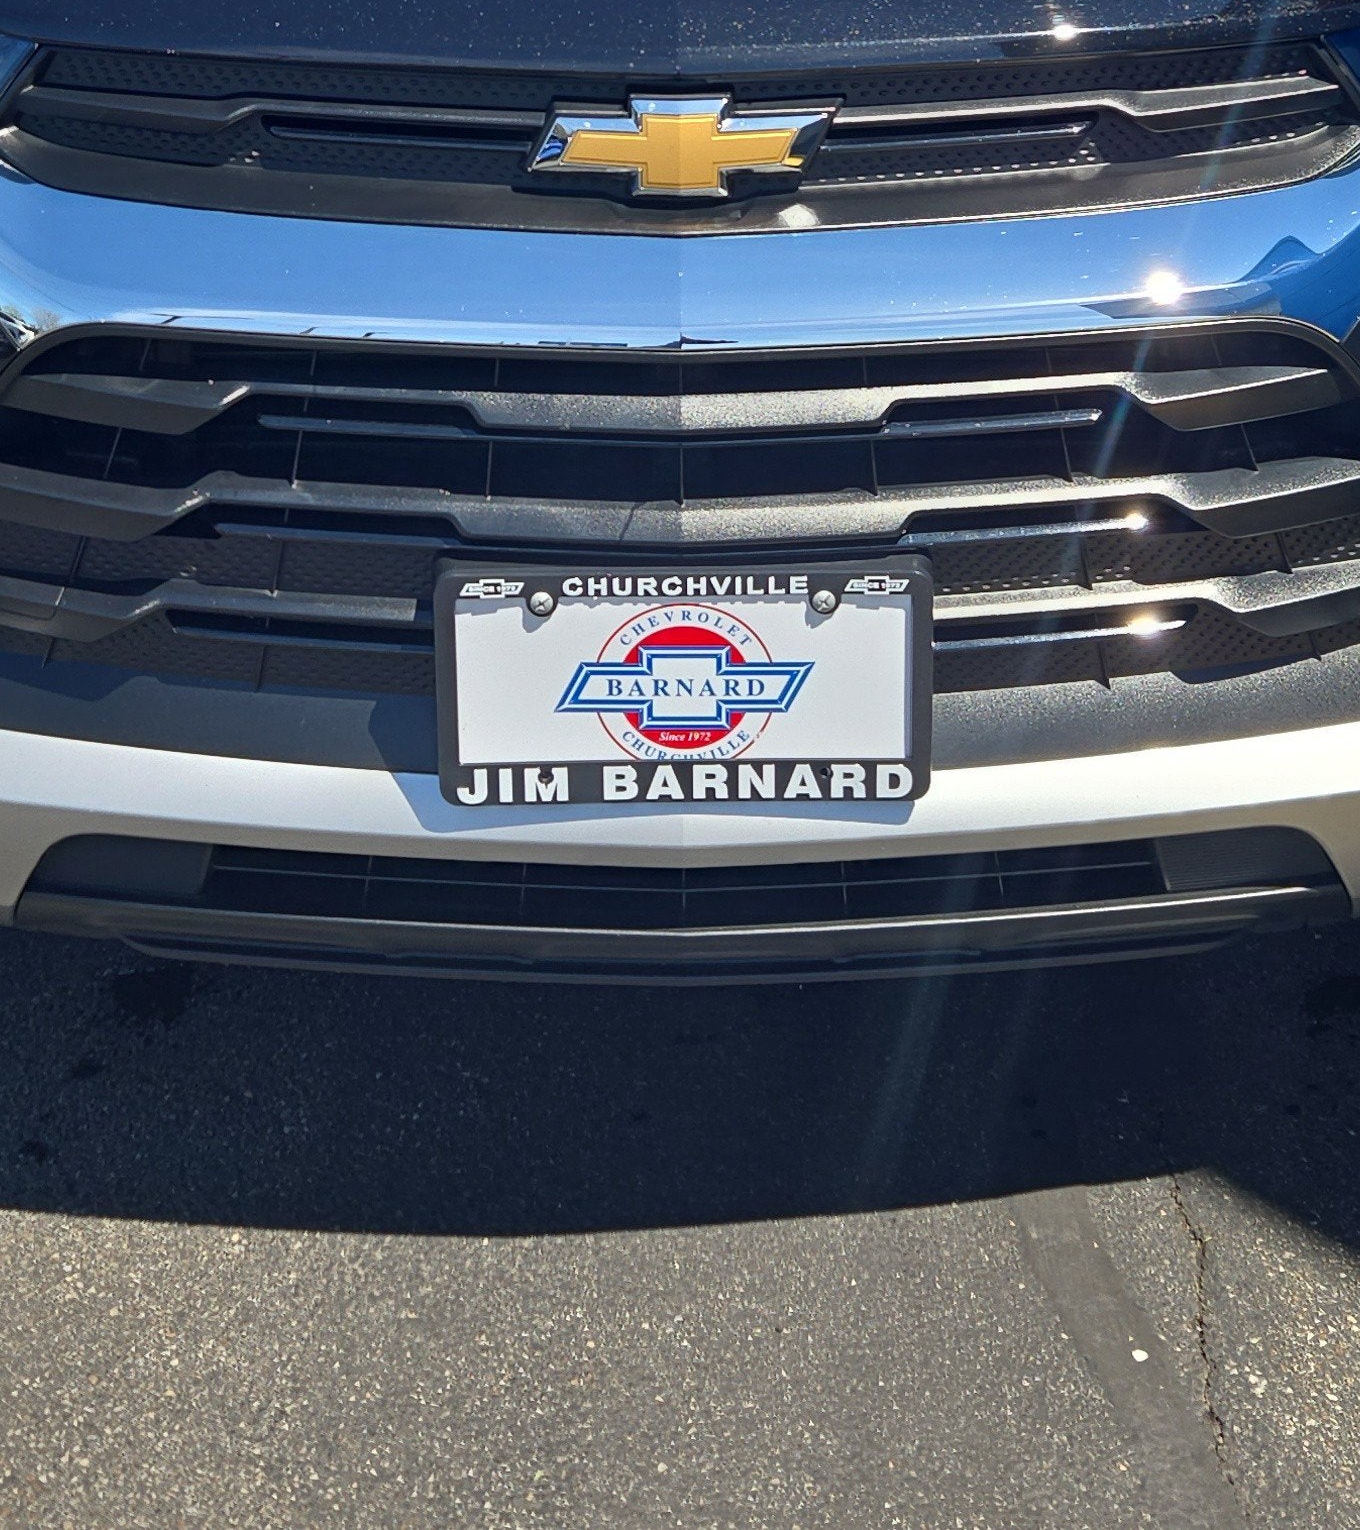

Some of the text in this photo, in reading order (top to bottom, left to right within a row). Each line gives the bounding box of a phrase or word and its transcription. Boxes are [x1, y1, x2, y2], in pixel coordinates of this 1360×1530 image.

[562, 575, 809, 598] CHURCHVILLE
[619, 610, 752, 646] CHEVROLET
[606, 678, 766, 697] BARNARD
[659, 731, 711, 742] Since 1972
[457, 764, 914, 805] JIM BARNARD
